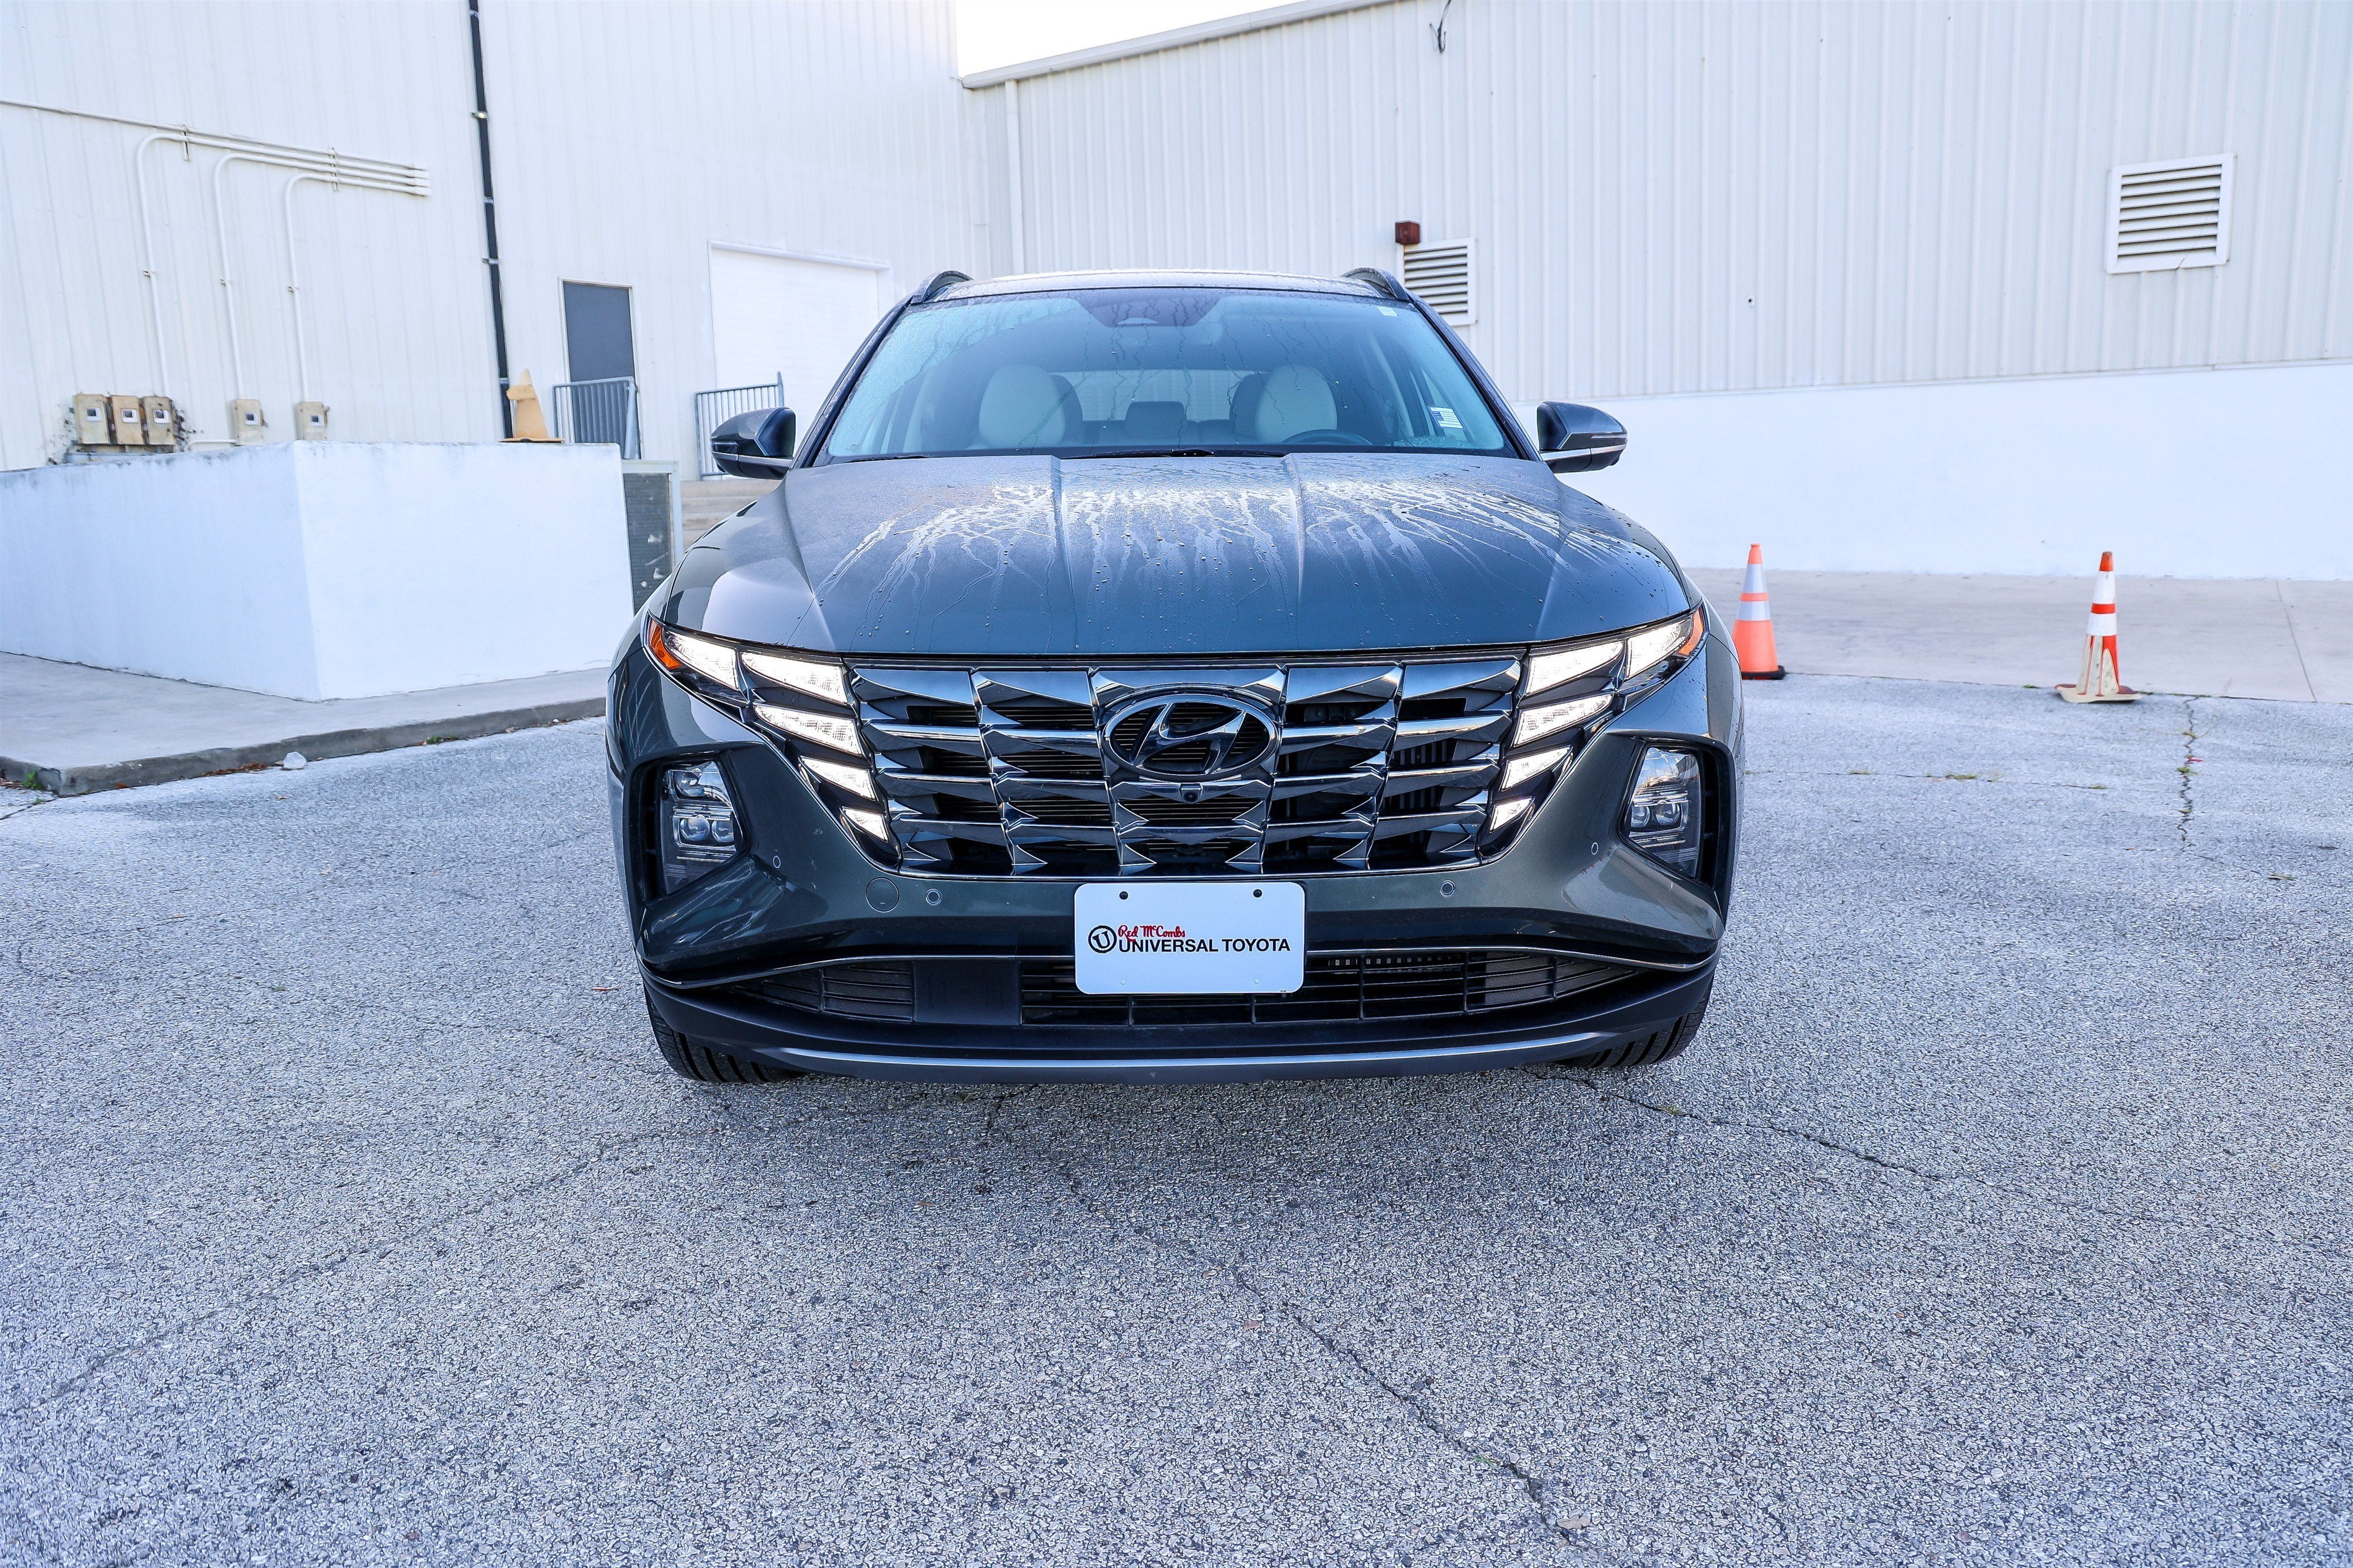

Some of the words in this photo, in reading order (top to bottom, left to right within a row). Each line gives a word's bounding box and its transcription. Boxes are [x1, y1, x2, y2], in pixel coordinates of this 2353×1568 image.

[1118, 925, 1139, 942] Red
[1140, 925, 1186, 938] McCombs
[1119, 939, 1219, 952] UNIVERSAL
[1222, 938, 1291, 952] TOYOTA
